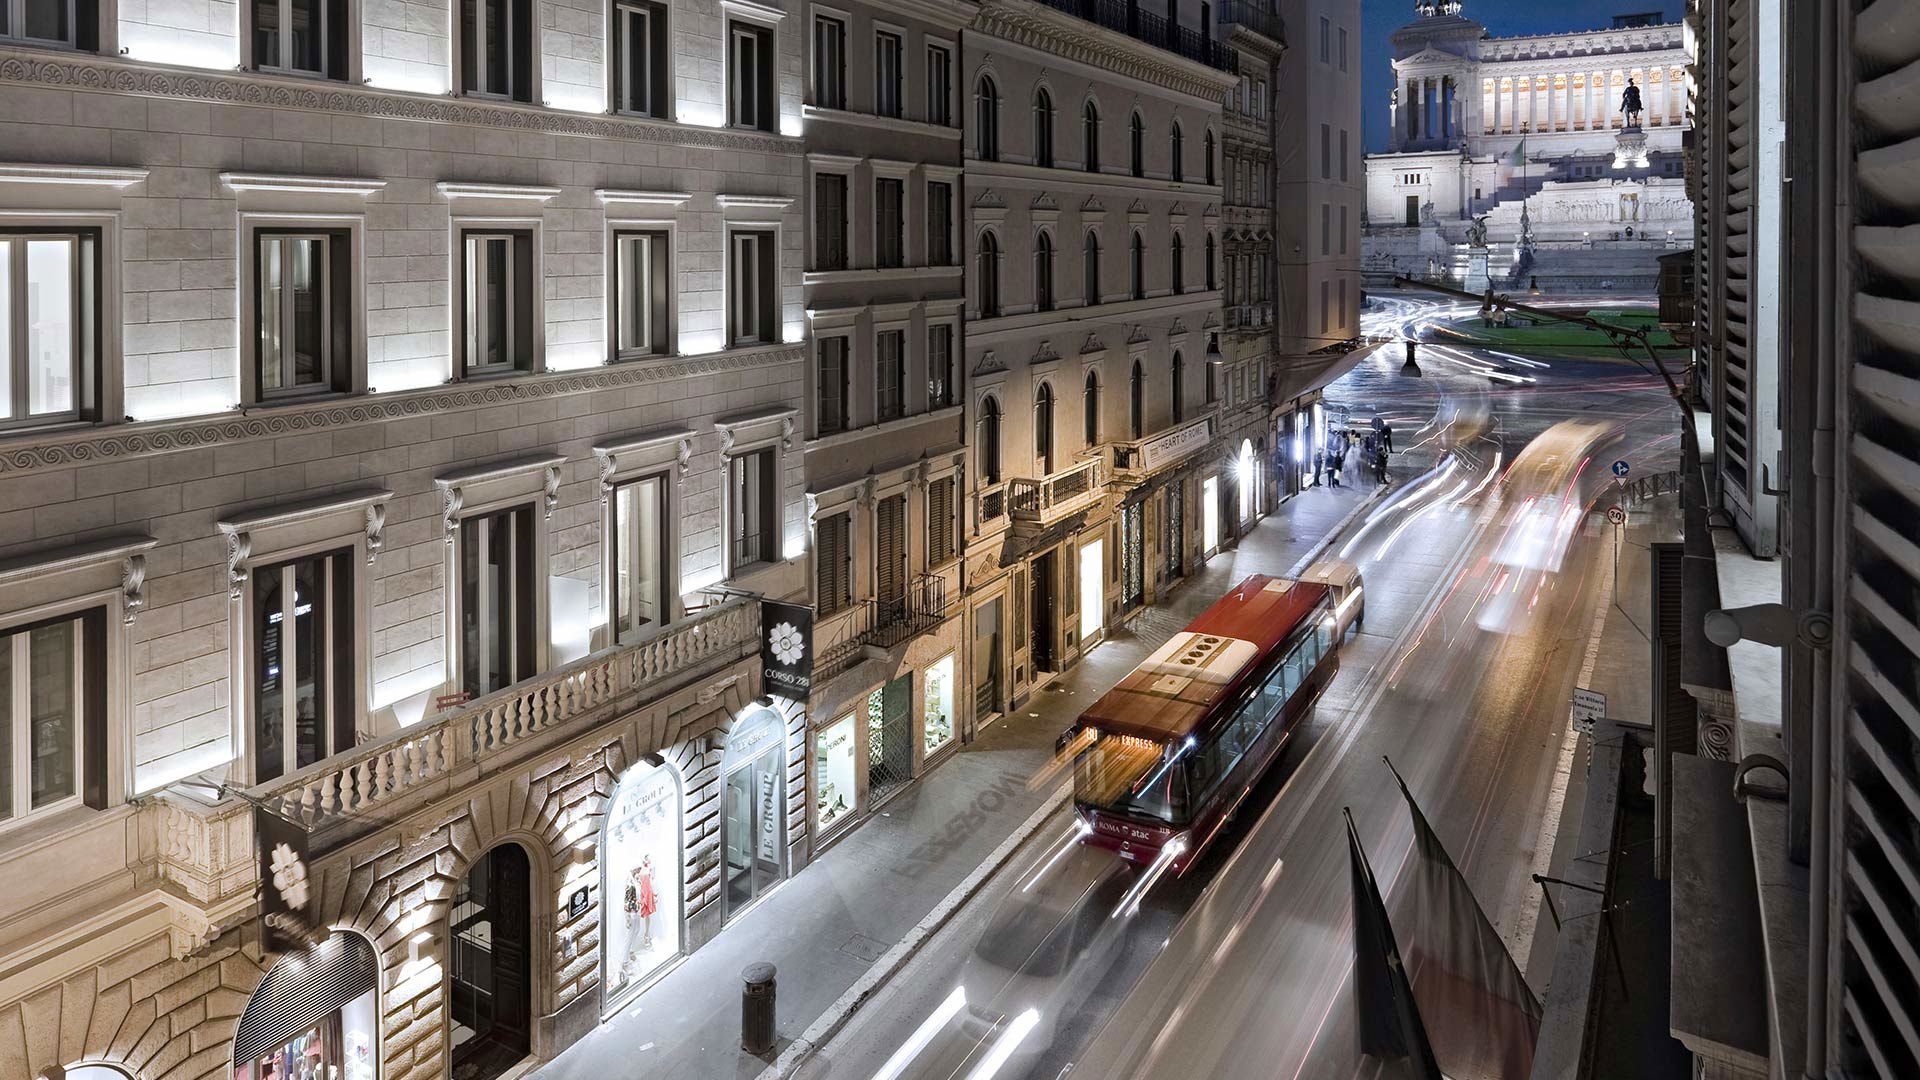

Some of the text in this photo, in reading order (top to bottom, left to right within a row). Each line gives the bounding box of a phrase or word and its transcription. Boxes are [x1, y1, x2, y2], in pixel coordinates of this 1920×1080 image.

[1610, 511, 1621, 520] 30
[765, 669, 794, 684] CORSO
[1121, 735, 1153, 750] EXPRESS
[764, 775, 774, 859] LE GROUP
[1099, 821, 1120, 833] ROMA
[1131, 829, 1150, 840] atac
